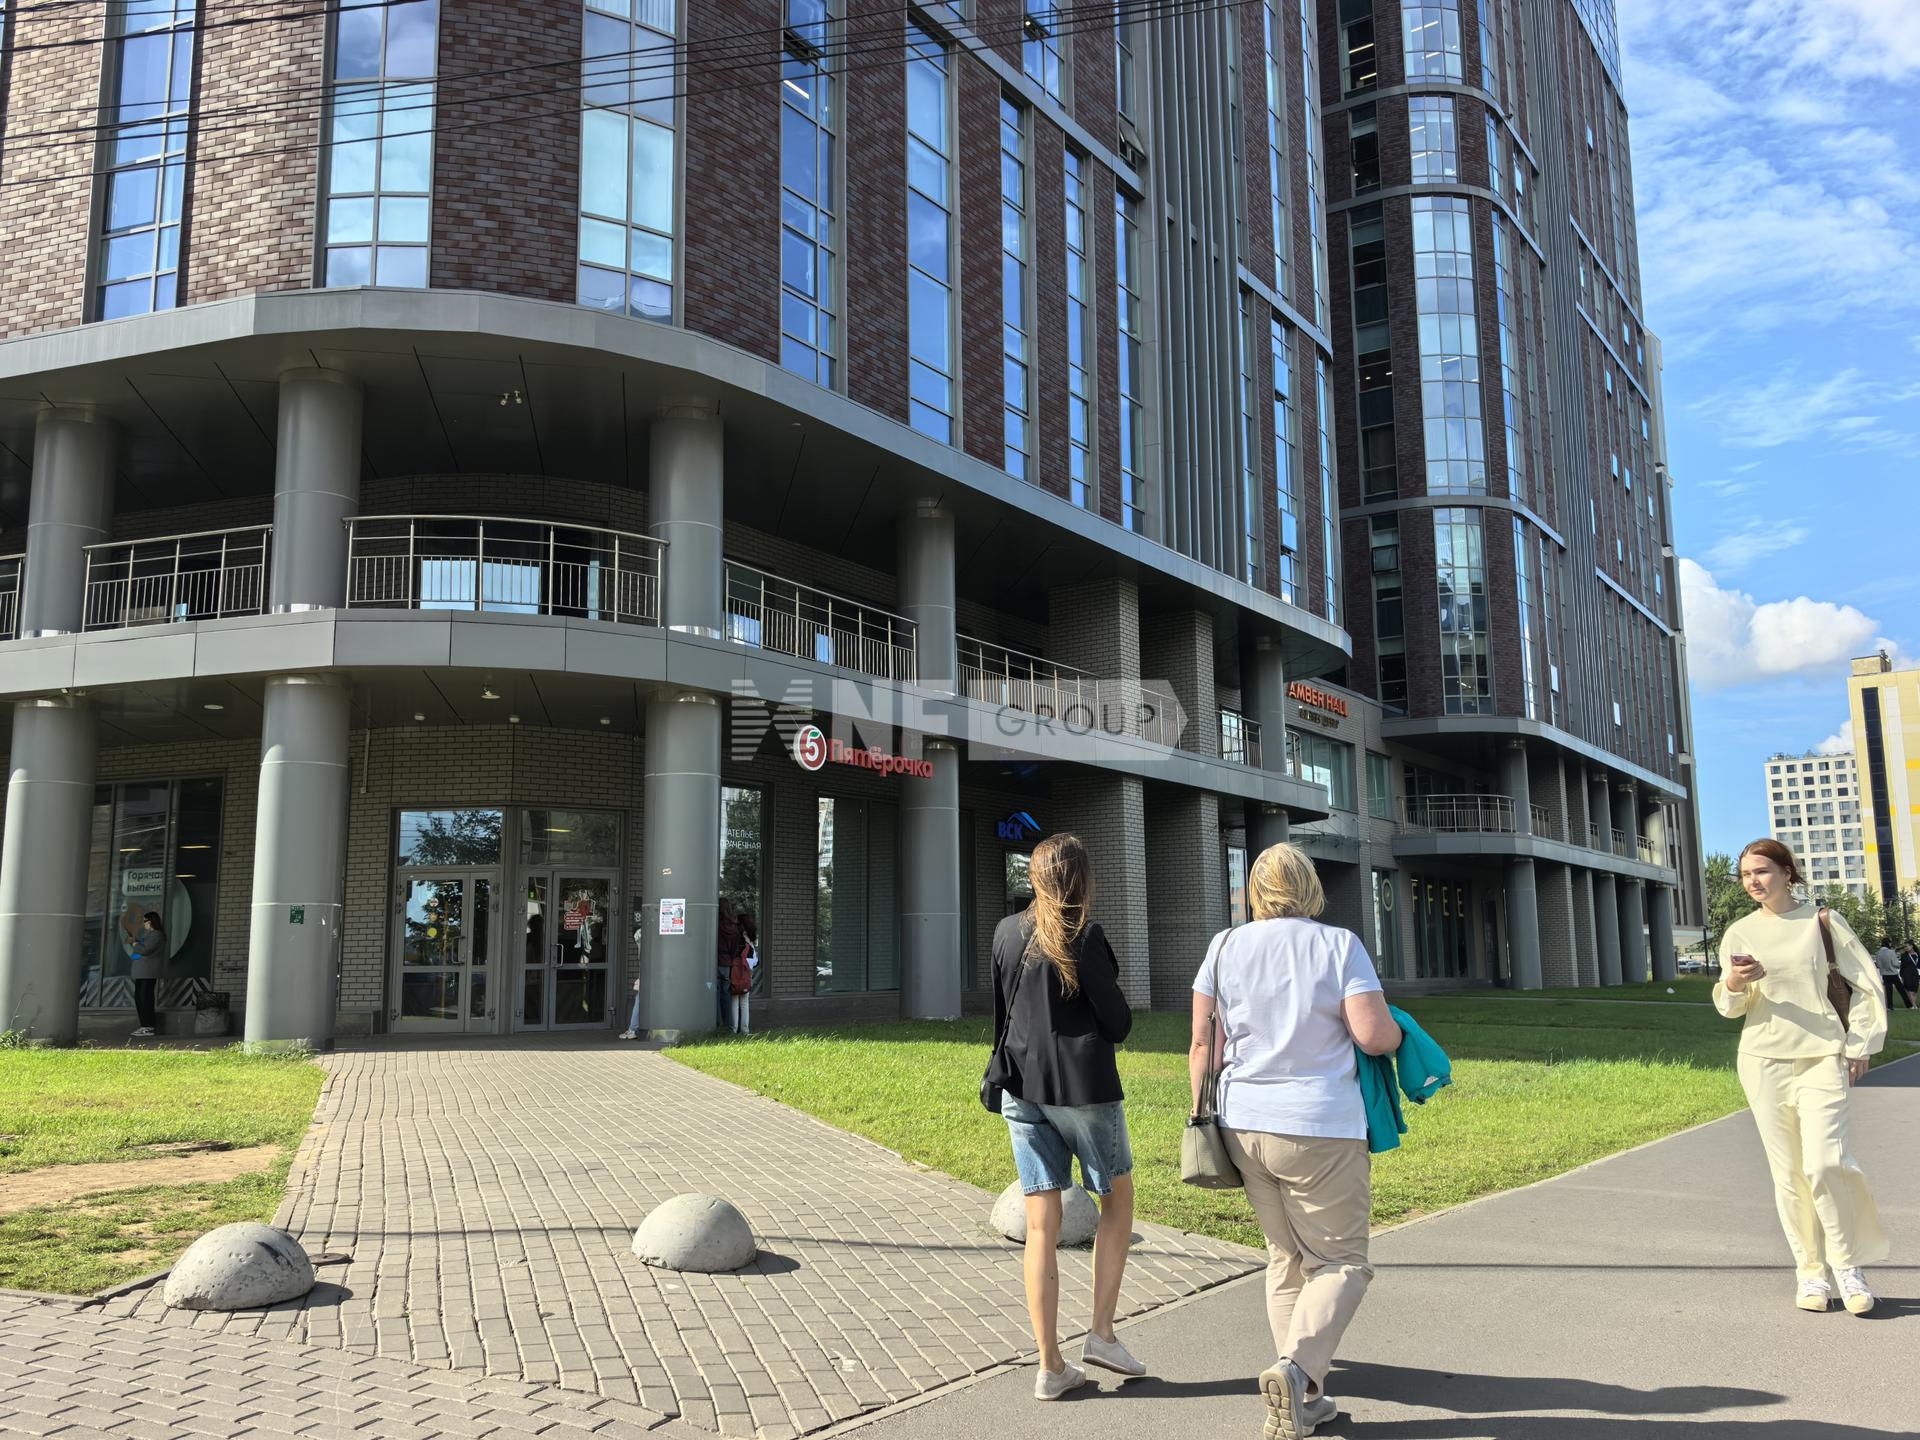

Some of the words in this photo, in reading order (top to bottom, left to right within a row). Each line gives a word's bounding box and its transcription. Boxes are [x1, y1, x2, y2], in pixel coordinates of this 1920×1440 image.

[1287, 680, 1325, 708] AMBER
[1326, 693, 1349, 718] HALL
[827, 738, 935, 779] Пятёрочка
[727, 828, 754, 839] АТЕЛЬЕ
[997, 820, 1023, 841] ВСК
[127, 884, 161, 893] выпечк
